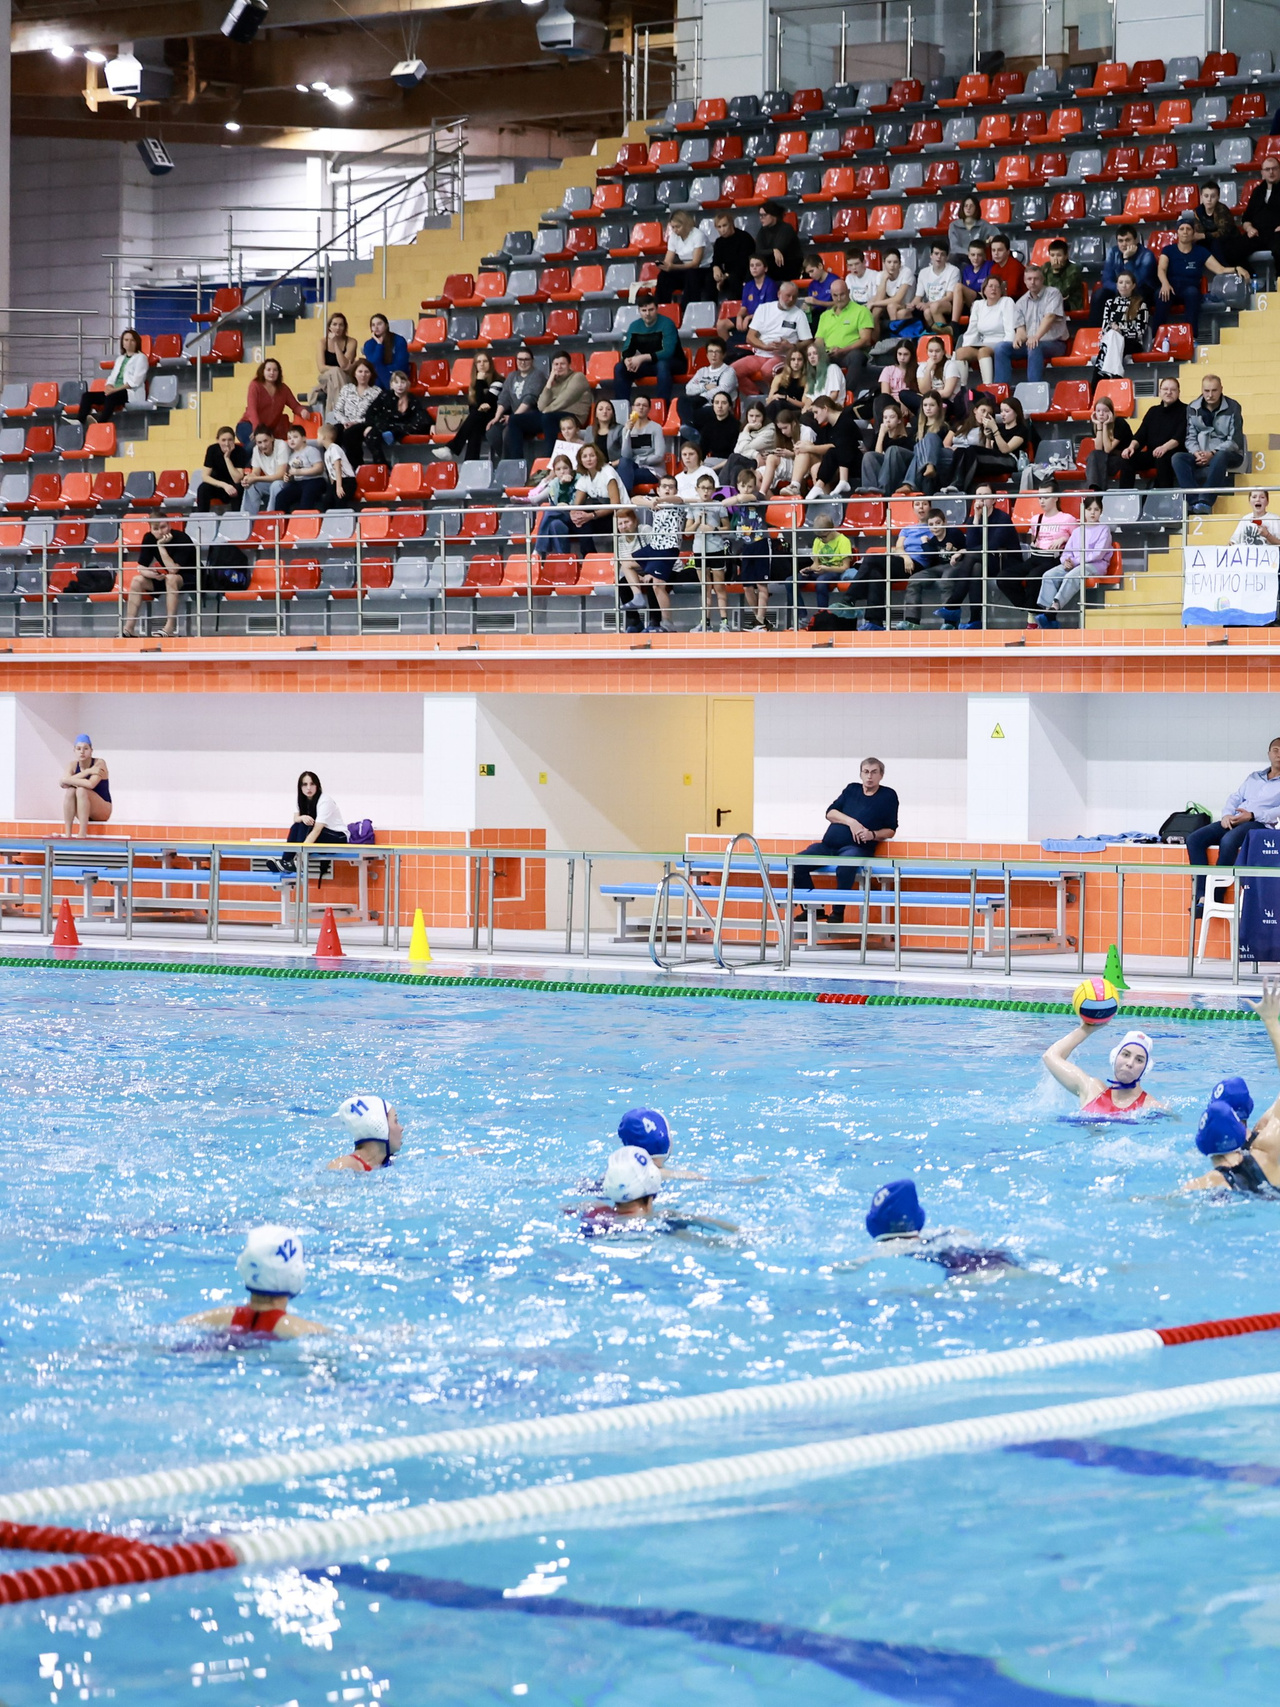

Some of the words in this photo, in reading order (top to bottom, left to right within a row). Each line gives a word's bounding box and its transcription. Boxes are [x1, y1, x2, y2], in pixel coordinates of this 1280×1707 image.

[1258, 295, 1267, 311] 6
[316, 305, 323, 318] 7
[254, 347, 261, 360] 6
[998, 385, 1005, 393] 27
[1079, 384, 1086, 392] 29
[1121, 381, 1128, 390] 30
[189, 396, 197, 409] 5
[127, 446, 134, 457] 4
[1256, 452, 1265, 470] 3
[1193, 517, 1203, 535] 2
[1129, 577, 1136, 591] 1
[1214, 1084, 1224, 1099] 9
[350, 1099, 369, 1117] 11
[642, 1117, 656, 1133] 4
[635, 1152, 647, 1167] 6
[873, 1189, 890, 1206] 5
[276, 1239, 296, 1262] 12
